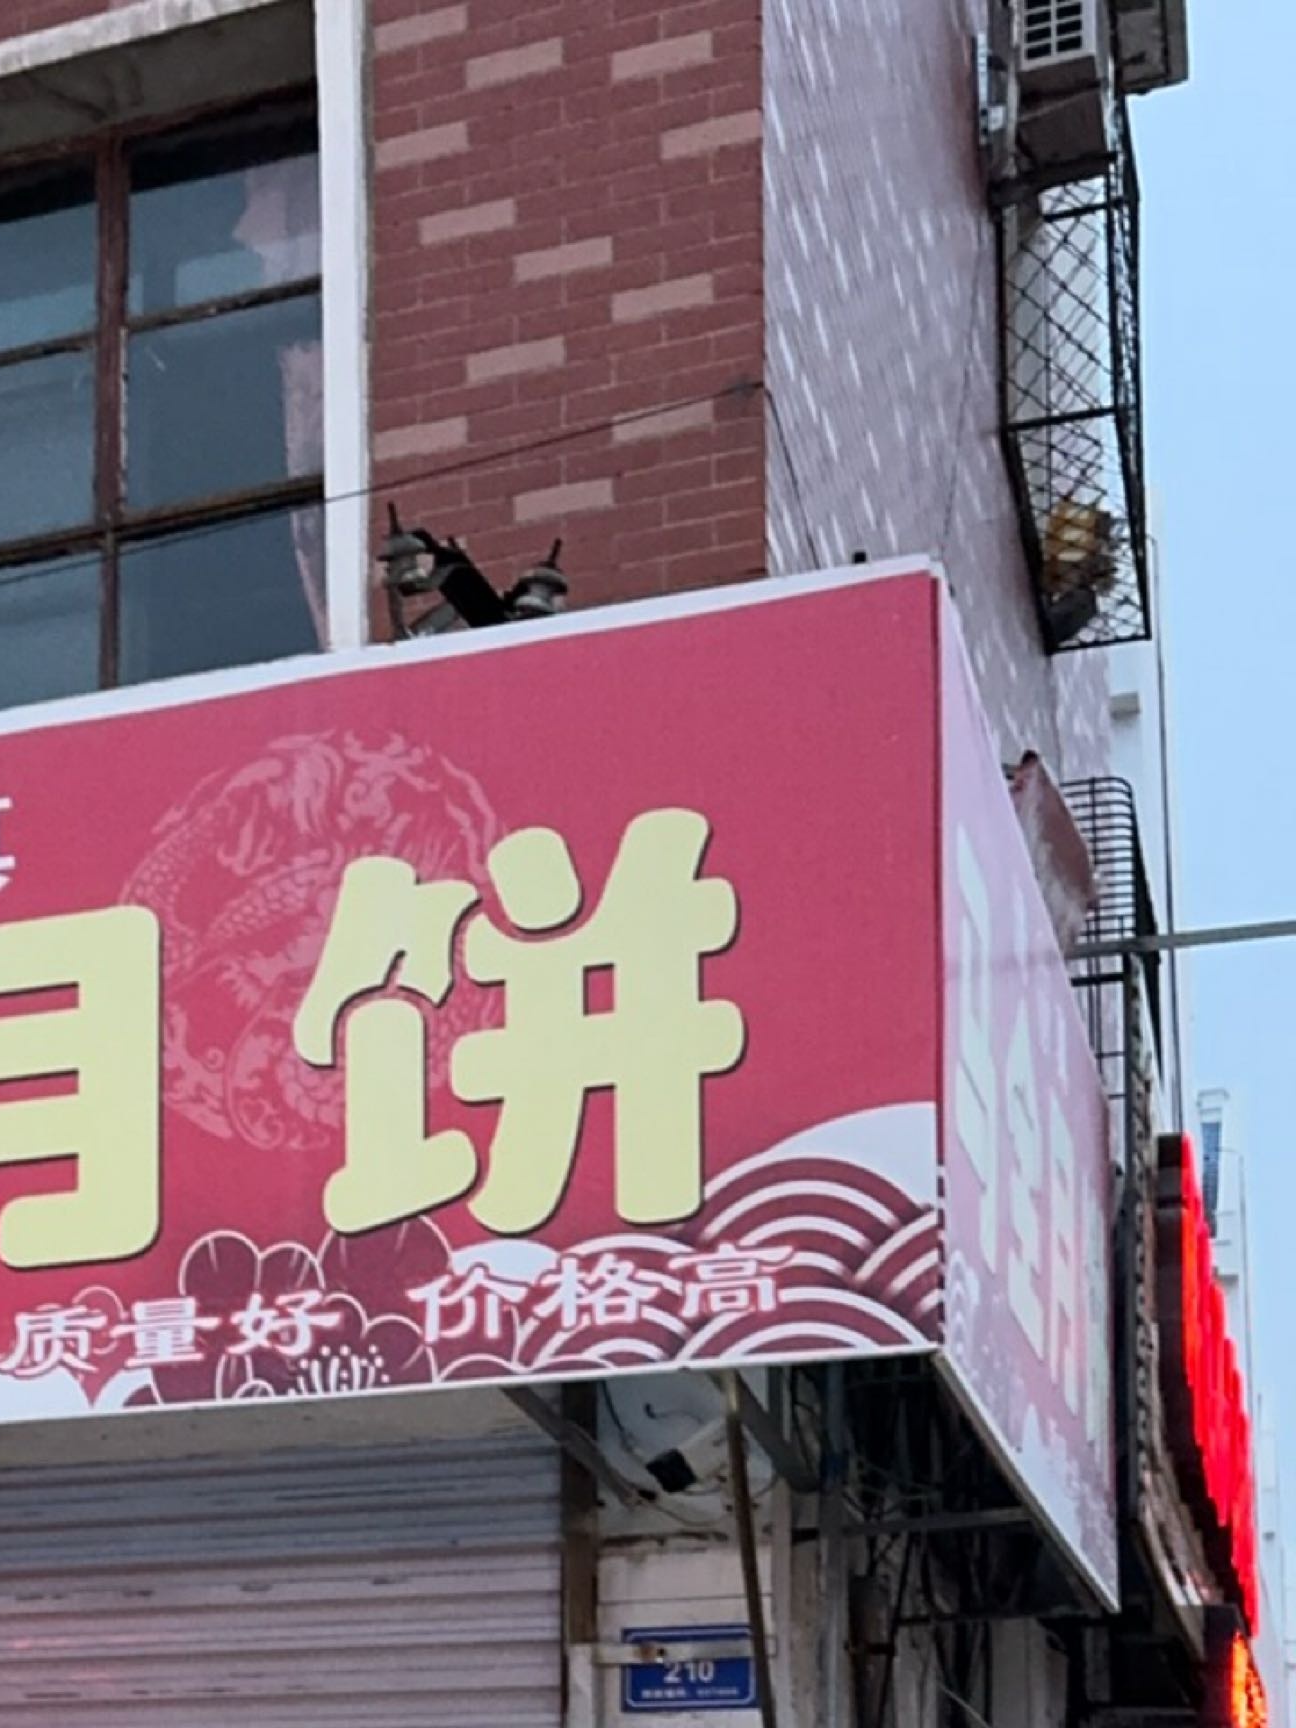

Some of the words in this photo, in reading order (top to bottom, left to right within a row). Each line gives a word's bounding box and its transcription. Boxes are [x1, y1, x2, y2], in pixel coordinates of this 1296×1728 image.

[405, 1244, 793, 1344] 价格高
[664, 1660, 715, 1684] 210
